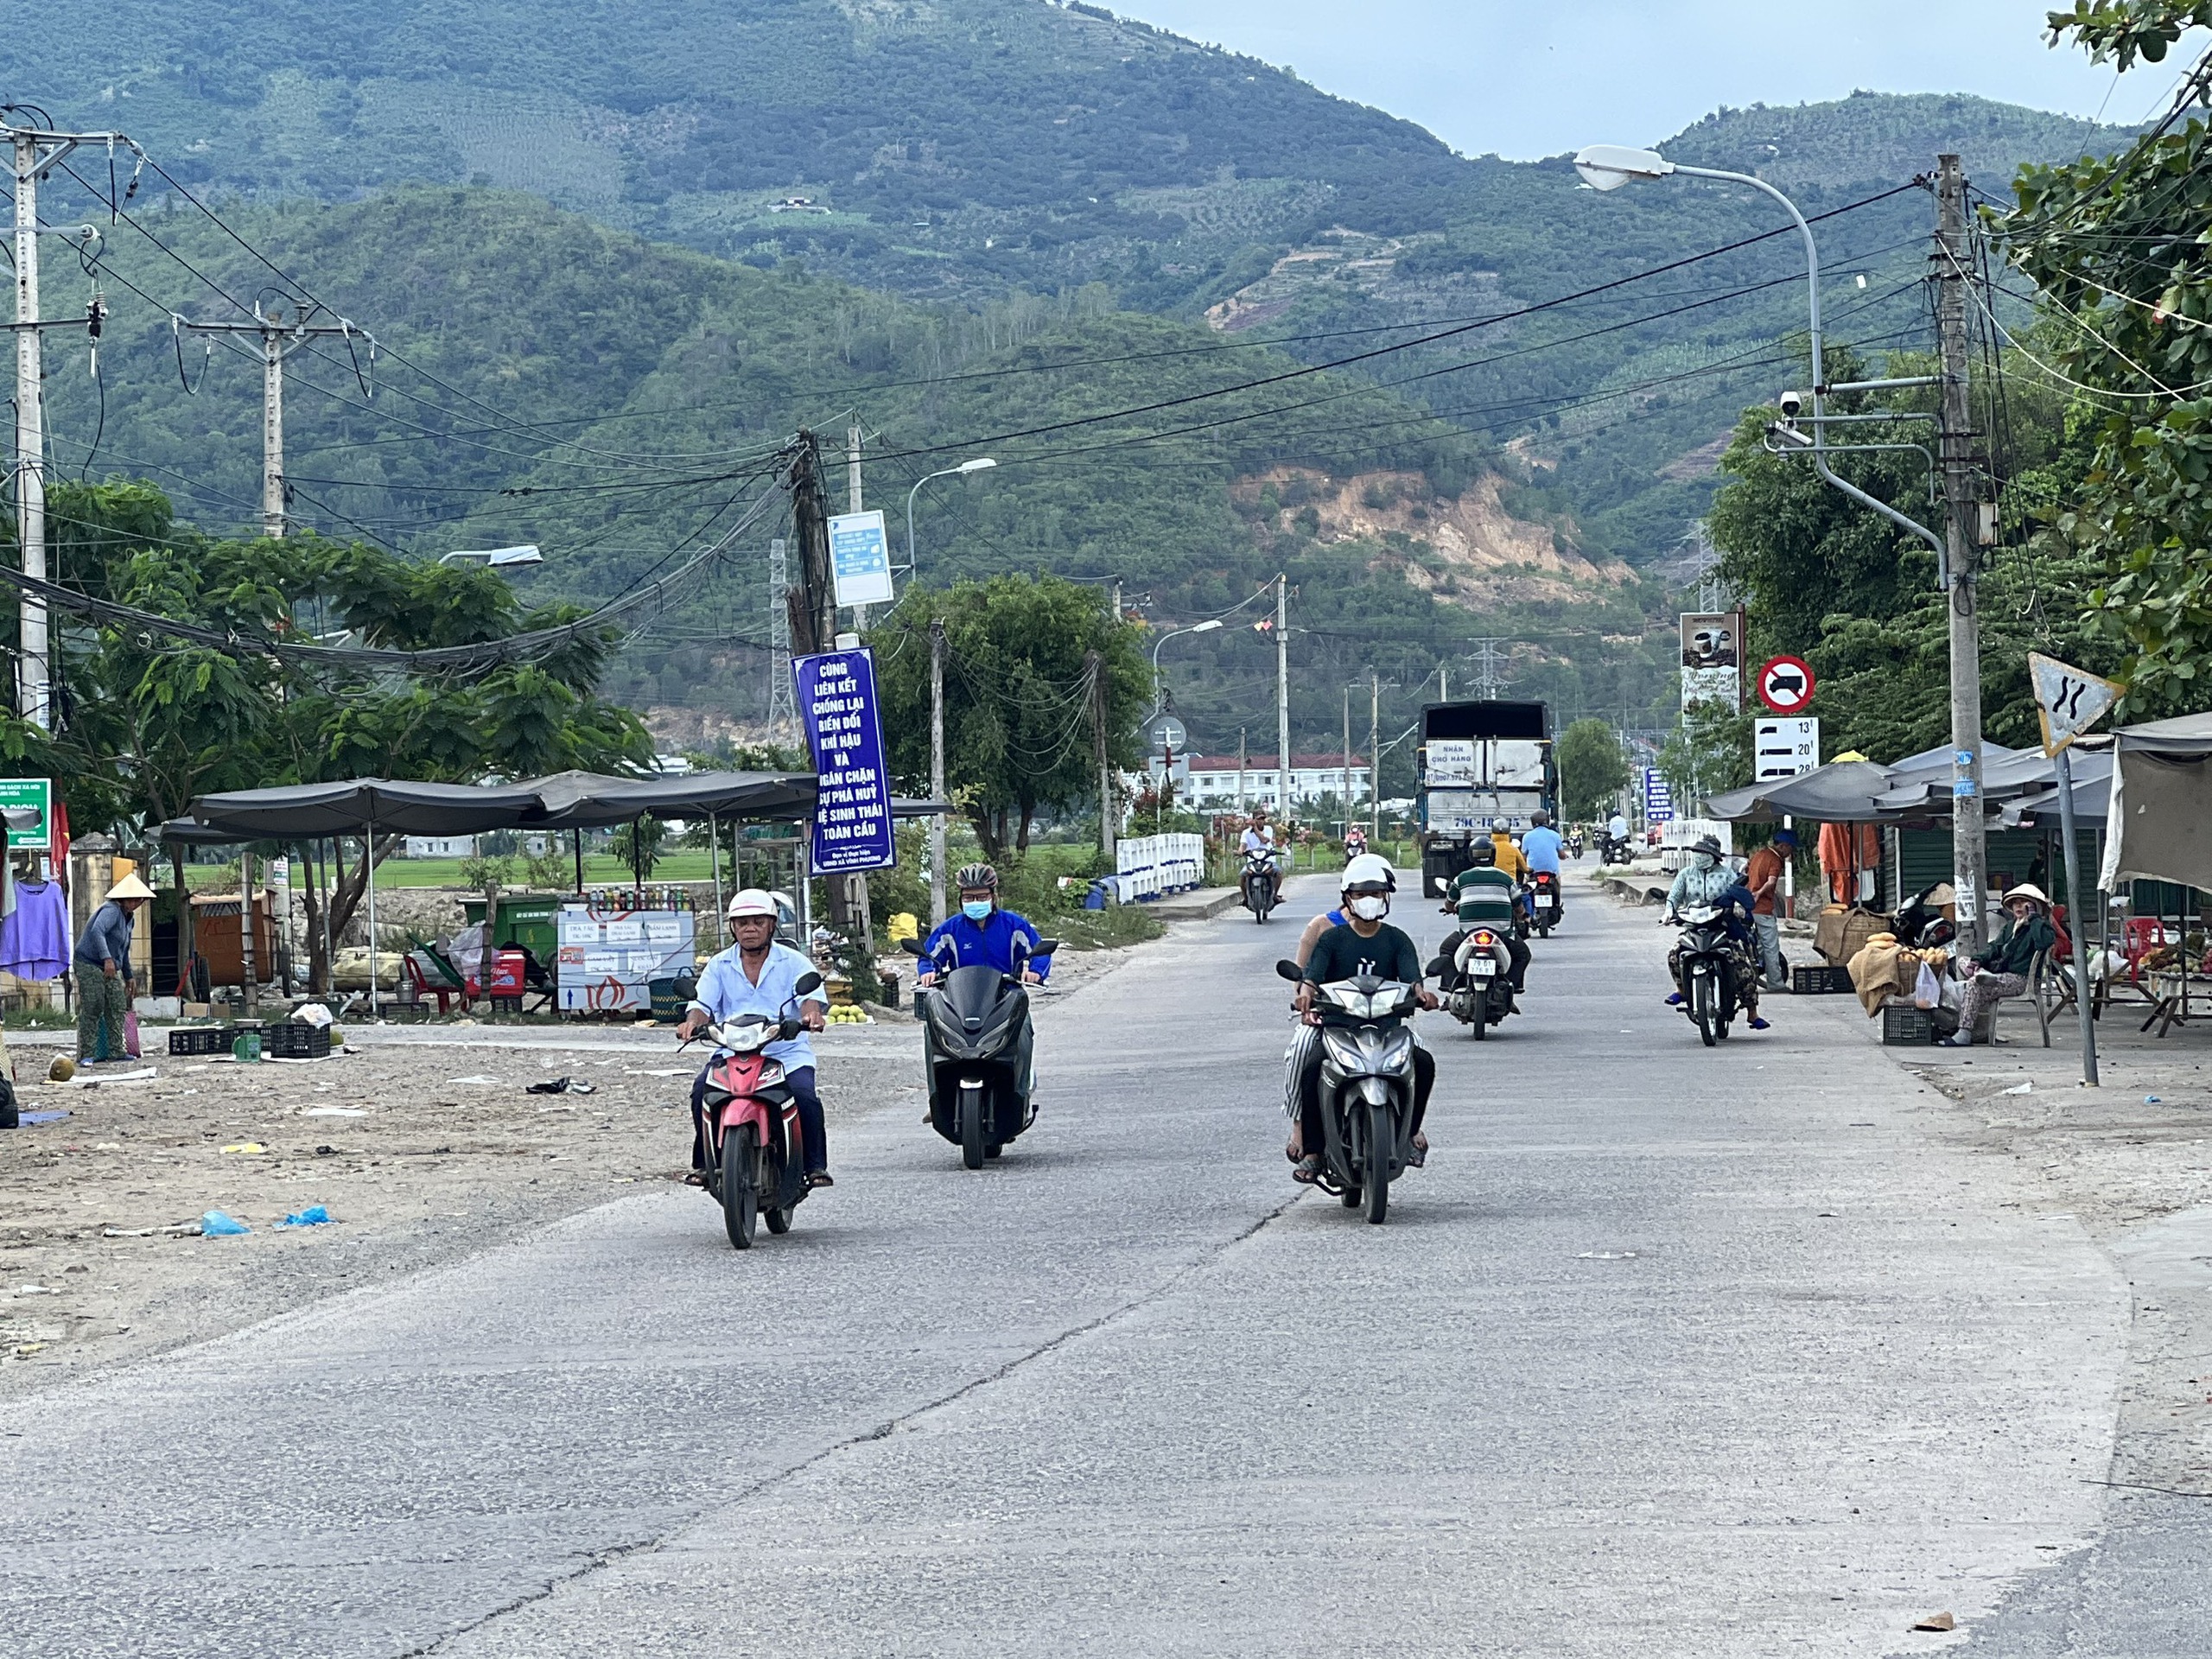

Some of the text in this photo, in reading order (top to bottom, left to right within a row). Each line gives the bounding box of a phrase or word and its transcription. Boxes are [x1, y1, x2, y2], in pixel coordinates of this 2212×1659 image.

[819, 662, 847, 677] CÙNG
[814, 677, 856, 696] LIÊN KẾT
[812, 696, 864, 715] CHỐNG LẠI
[818, 712, 861, 732] BIẾN ĐỔI
[821, 733, 861, 750] KHÍ HẬU
[834, 751, 849, 766] VÀ
[845, 767, 875, 784] CHẶN
[819, 791, 830, 807] SỰ
[832, 787, 854, 803] PHÁ
[830, 807, 855, 822] SINH
[857, 803, 882, 818] THÁI
[823, 825, 851, 840] TOÀN
